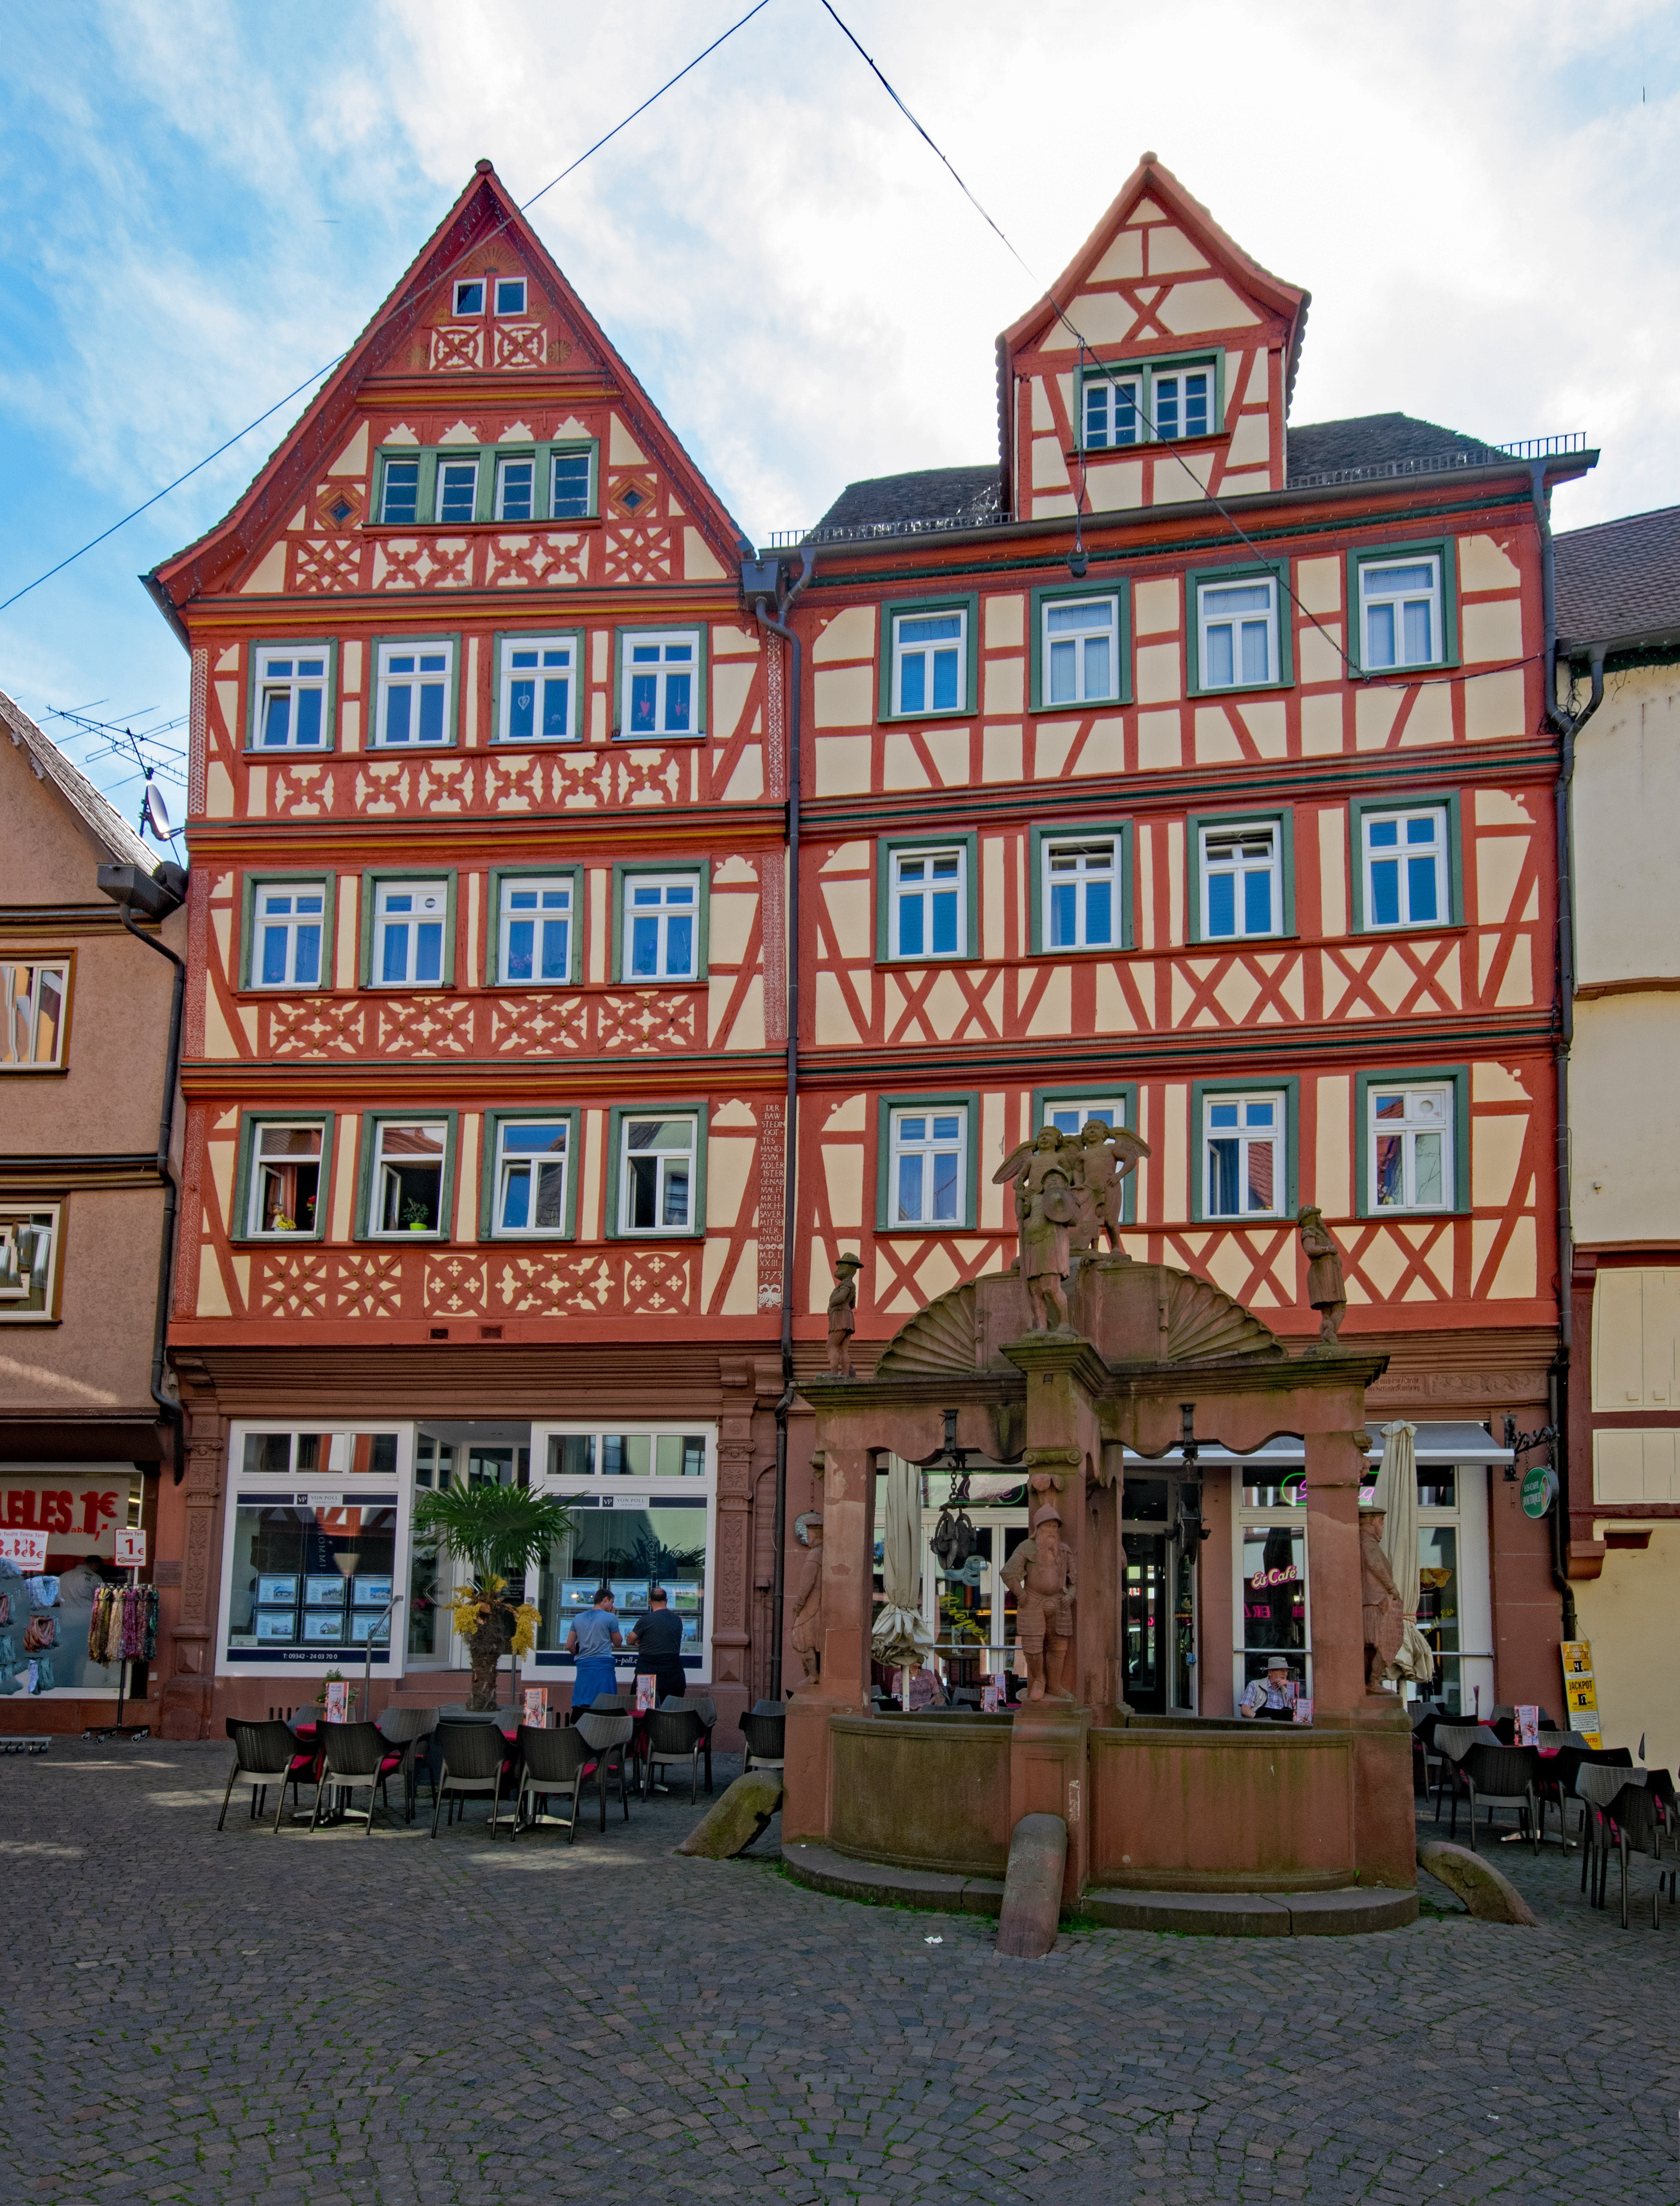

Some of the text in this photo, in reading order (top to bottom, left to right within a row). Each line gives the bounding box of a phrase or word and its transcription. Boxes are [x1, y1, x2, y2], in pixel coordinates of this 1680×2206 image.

[760, 1271, 782, 1280] 1573
[125, 1538, 133, 1555] 1
[1252, 1566, 1296, 1588] Eis Café
[615, 1657, 638, 1666] n-poll.c
[1569, 1680, 1592, 1690] JACKPOT
